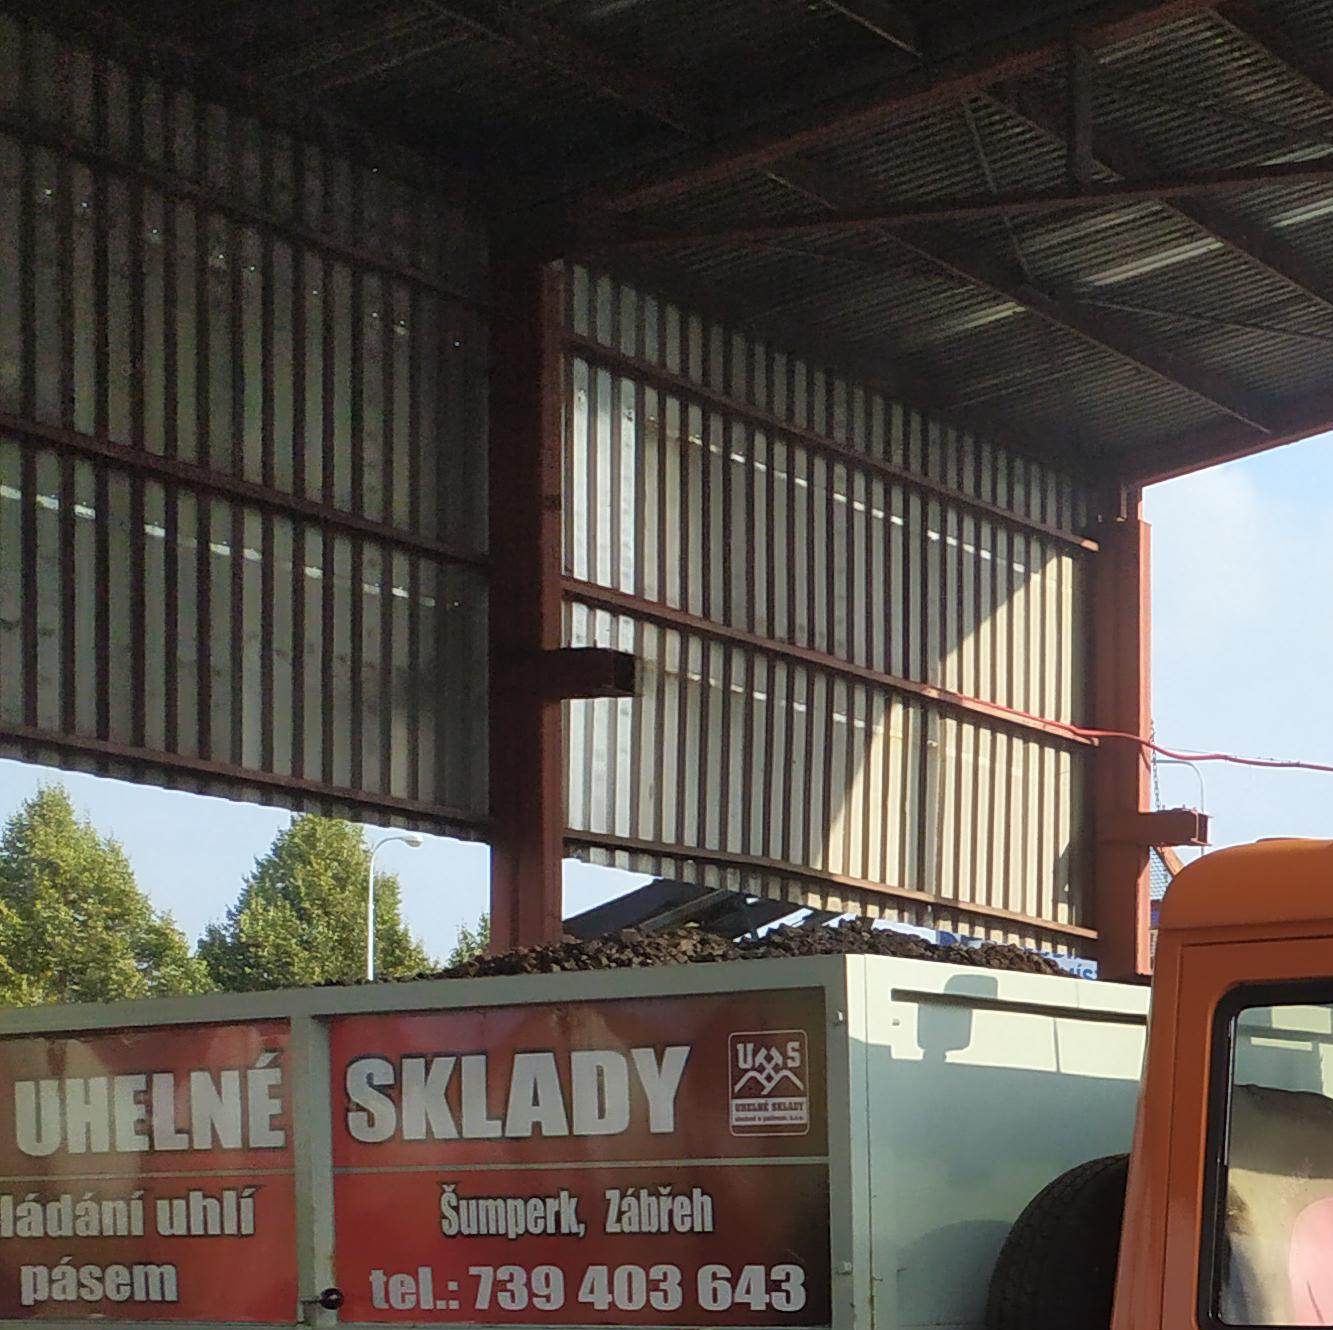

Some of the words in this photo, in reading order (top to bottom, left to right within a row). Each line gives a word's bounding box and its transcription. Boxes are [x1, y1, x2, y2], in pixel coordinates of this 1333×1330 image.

[15, 1052, 286, 1157] UHELNÉ
[345, 1046, 691, 1143] SKLADY
[155, 1187, 257, 1236] uhlí
[440, 1184, 586, 1240] Šumperk,
[605, 1186, 714, 1234] Zábřeh
[20, 1256, 179, 1306] pásem
[368, 1265, 461, 1311] tel.:
[468, 1266, 565, 1311] 739
[577, 1264, 684, 1312] 403
[697, 1263, 807, 1312] 643
